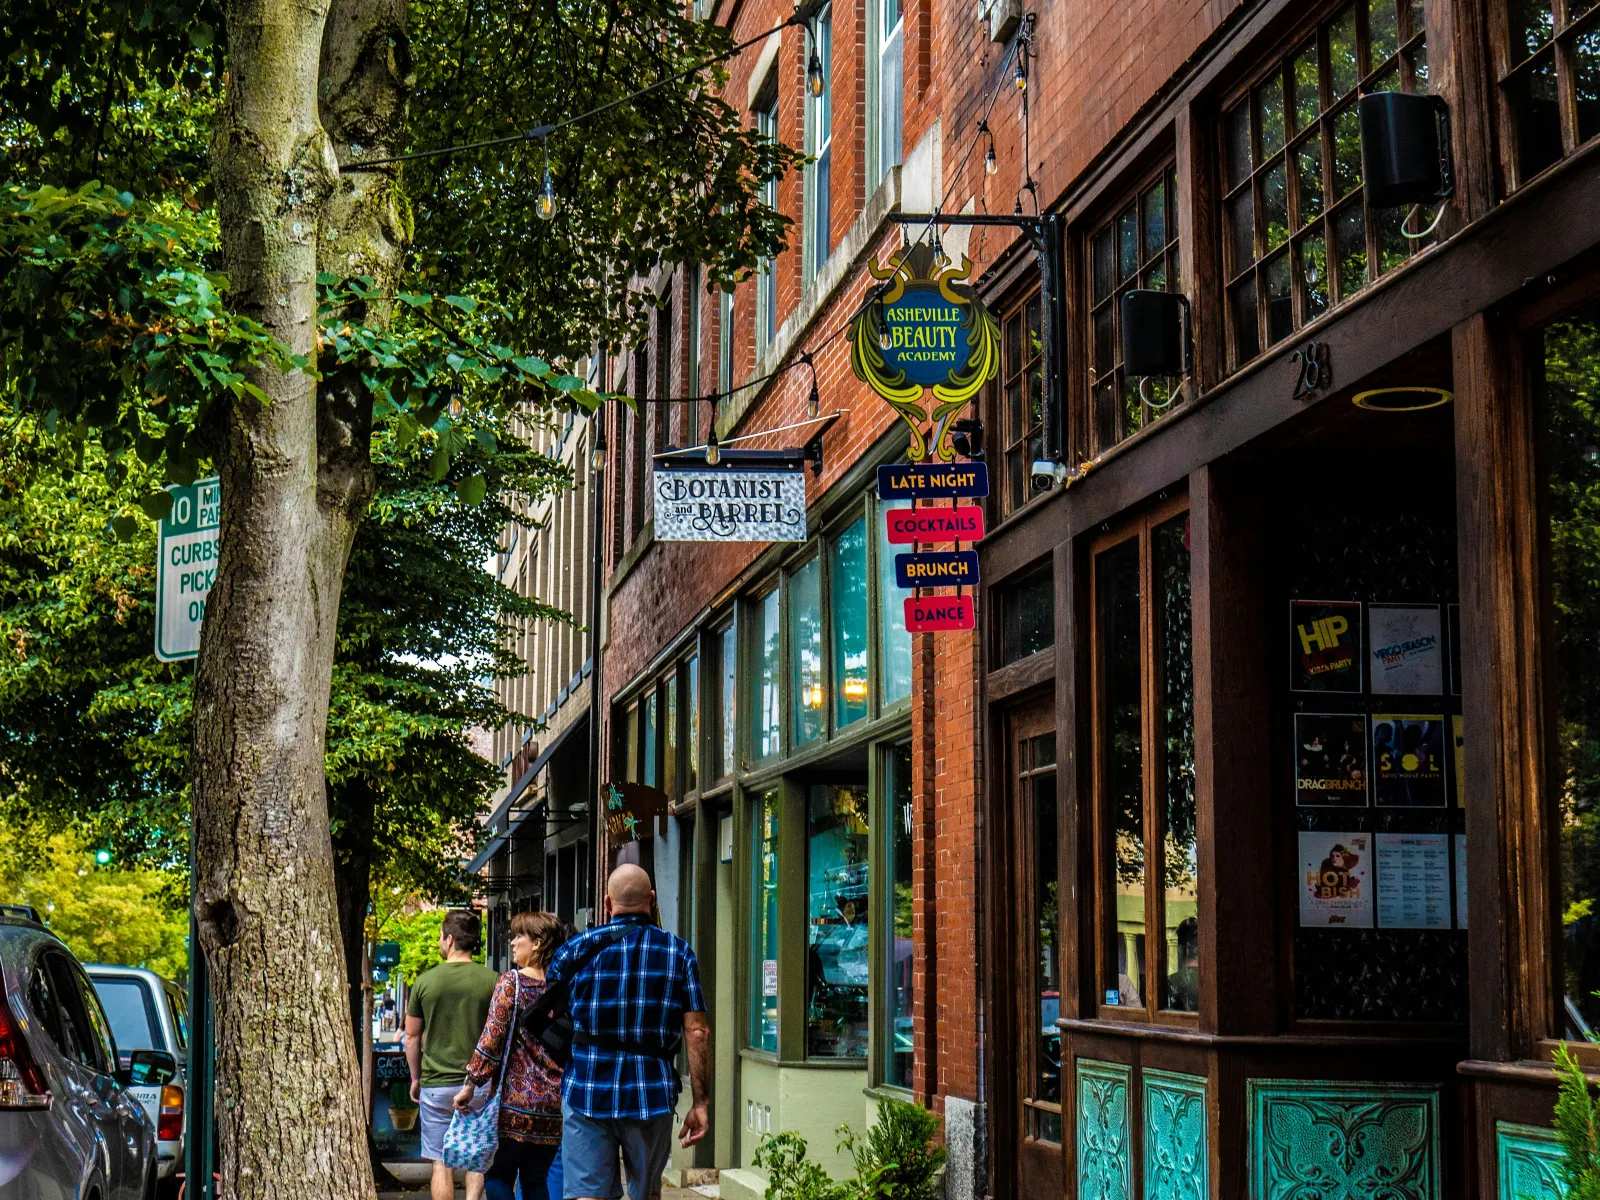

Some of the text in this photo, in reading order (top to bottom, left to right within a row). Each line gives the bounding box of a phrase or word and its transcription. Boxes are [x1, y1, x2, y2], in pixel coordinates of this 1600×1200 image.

[887, 307, 960, 322] ASHEVILLE
[891, 326, 957, 348] BEAUTY
[897, 351, 957, 362] ACADEMY
[890, 473, 976, 489] LATE NIGHT
[659, 479, 785, 500] BOTANIST
[674, 503, 800, 536] and BARREL
[894, 517, 976, 533] COCKTAILS
[906, 561, 969, 577] BRUNCH
[180, 568, 220, 594] PICK
[914, 606, 965, 622] DANCE
[1297, 615, 1349, 655] HIP
[1401, 634, 1437, 653] SEASON
[1329, 658, 1352, 671] PARTY
[1381, 651, 1406, 665] PARTY
[1380, 752, 1440, 772] SOL
[1306, 870, 1351, 887] HOT
[1320, 886, 1360, 899] BISH
